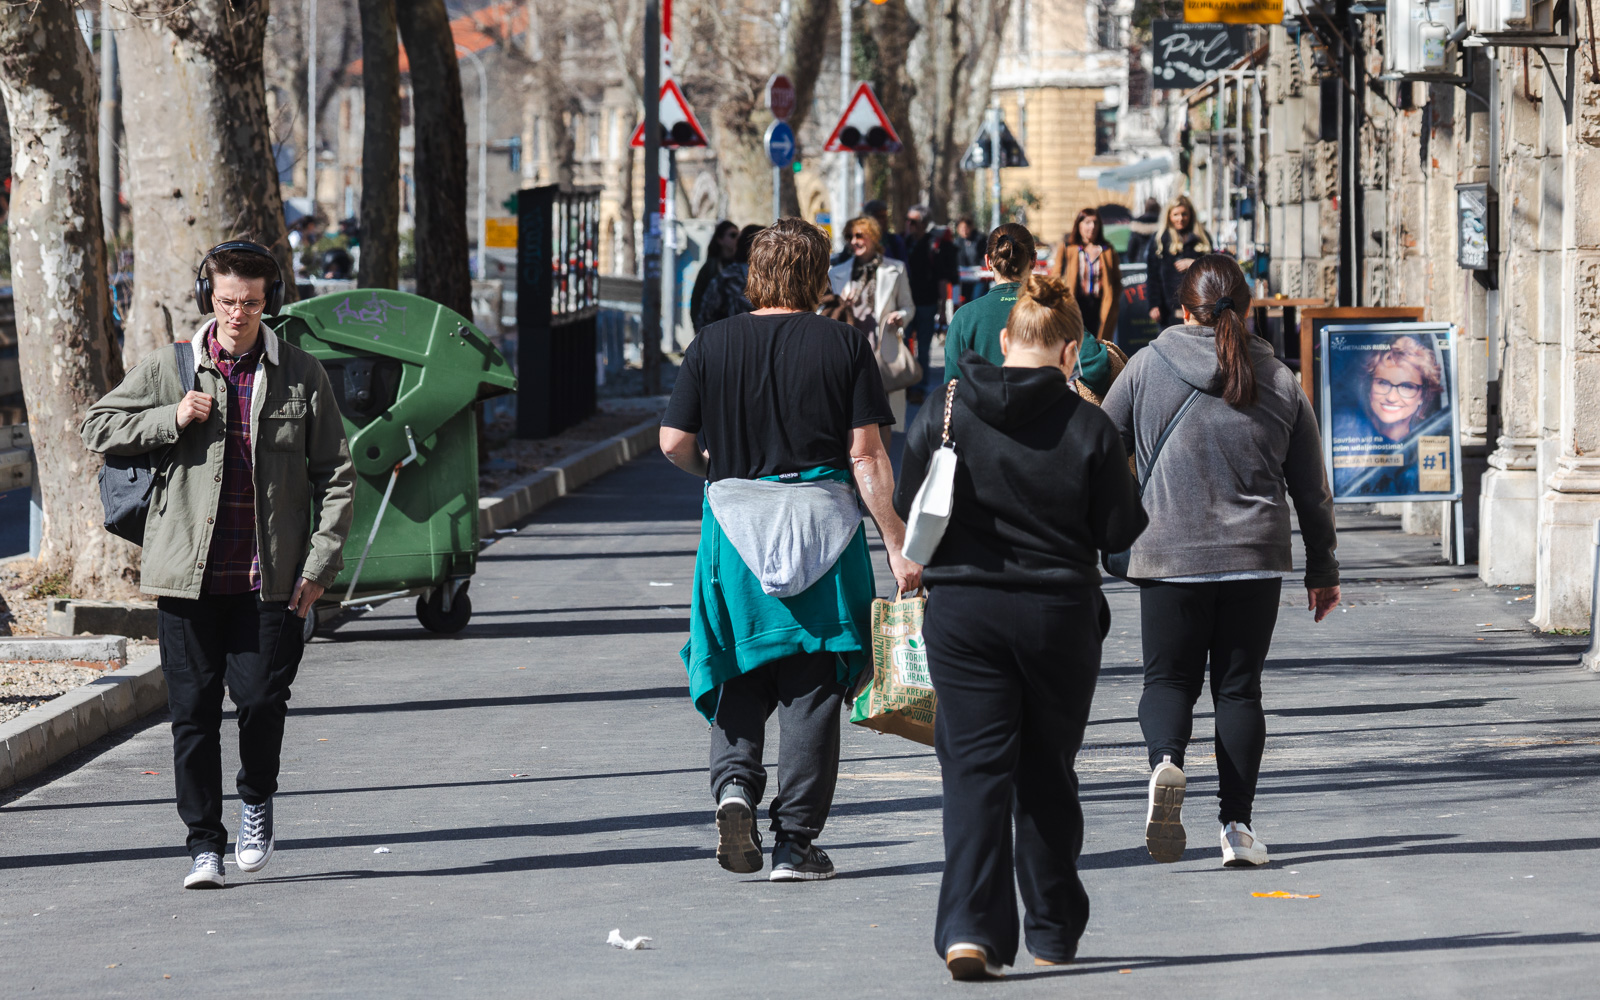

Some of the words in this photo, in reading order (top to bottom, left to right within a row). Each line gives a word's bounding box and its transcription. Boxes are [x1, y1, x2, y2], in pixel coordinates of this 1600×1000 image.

[1374, 456, 1401, 464] GRATIS
[1422, 451, 1447, 470] #1
[882, 601, 915, 613] PRIRODNI
[874, 636, 885, 668] NAMAZI
[906, 672, 930, 684] HRANE
[906, 687, 934, 700] KREKERI
[883, 693, 906, 704] BILJNI
[907, 696, 933, 710] NAPITCI
[911, 708, 934, 724] SUHO
